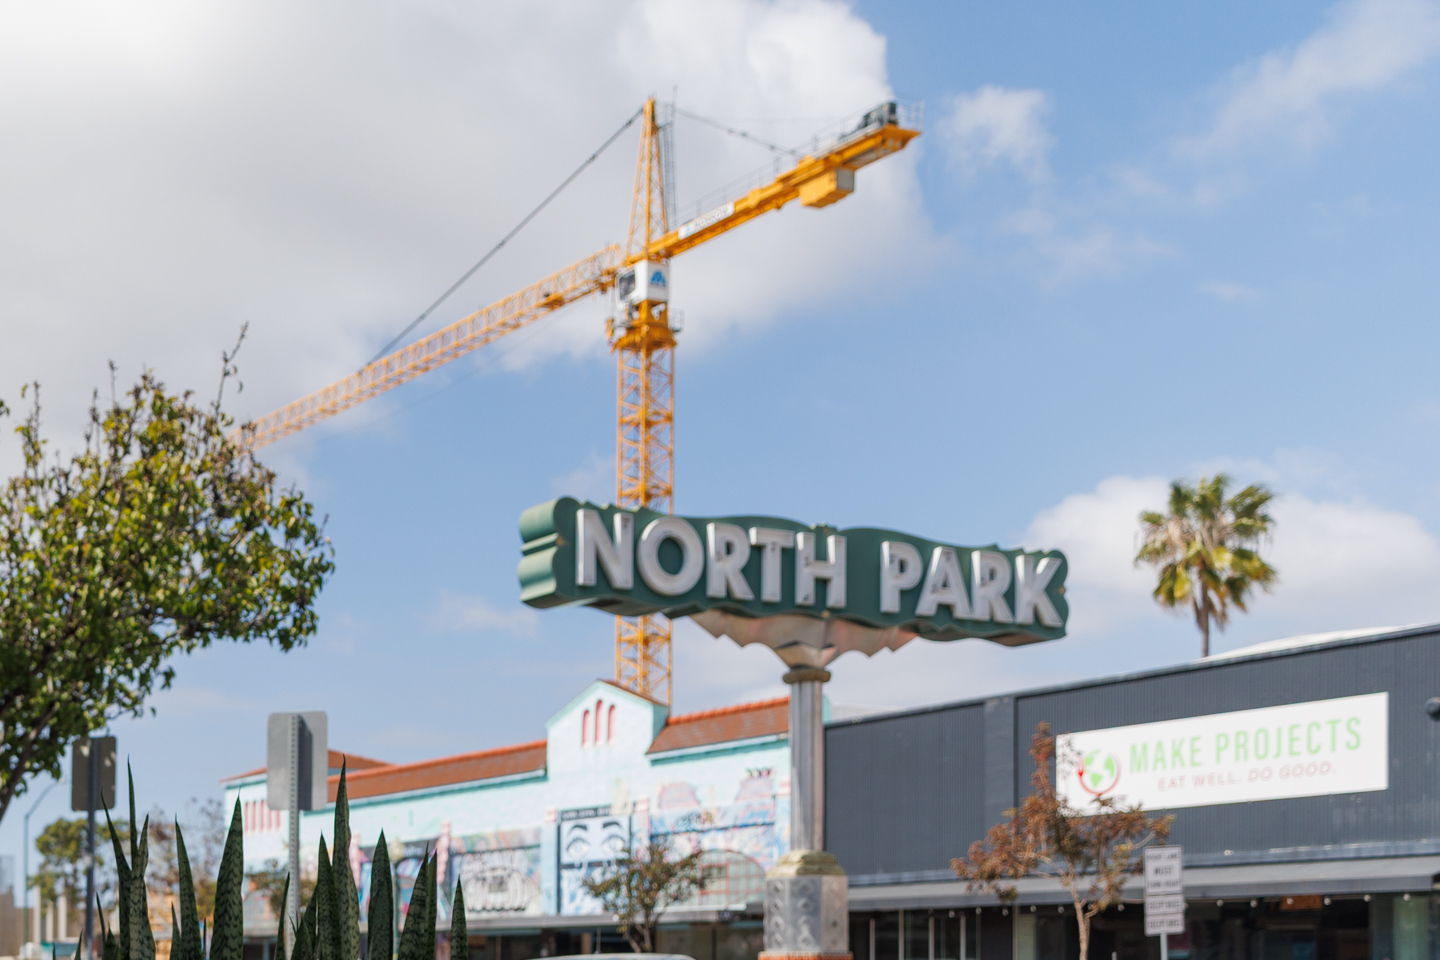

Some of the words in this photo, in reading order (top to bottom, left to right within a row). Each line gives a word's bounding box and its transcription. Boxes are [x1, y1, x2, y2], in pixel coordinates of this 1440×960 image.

[574, 508, 847, 609] NORTH
[879, 540, 1064, 628] PARK
[1129, 736, 1202, 773] MAKE
[1215, 717, 1362, 764] PROJECTS
[1158, 775, 1187, 792] EAT
[1247, 766, 1273, 783] DO
